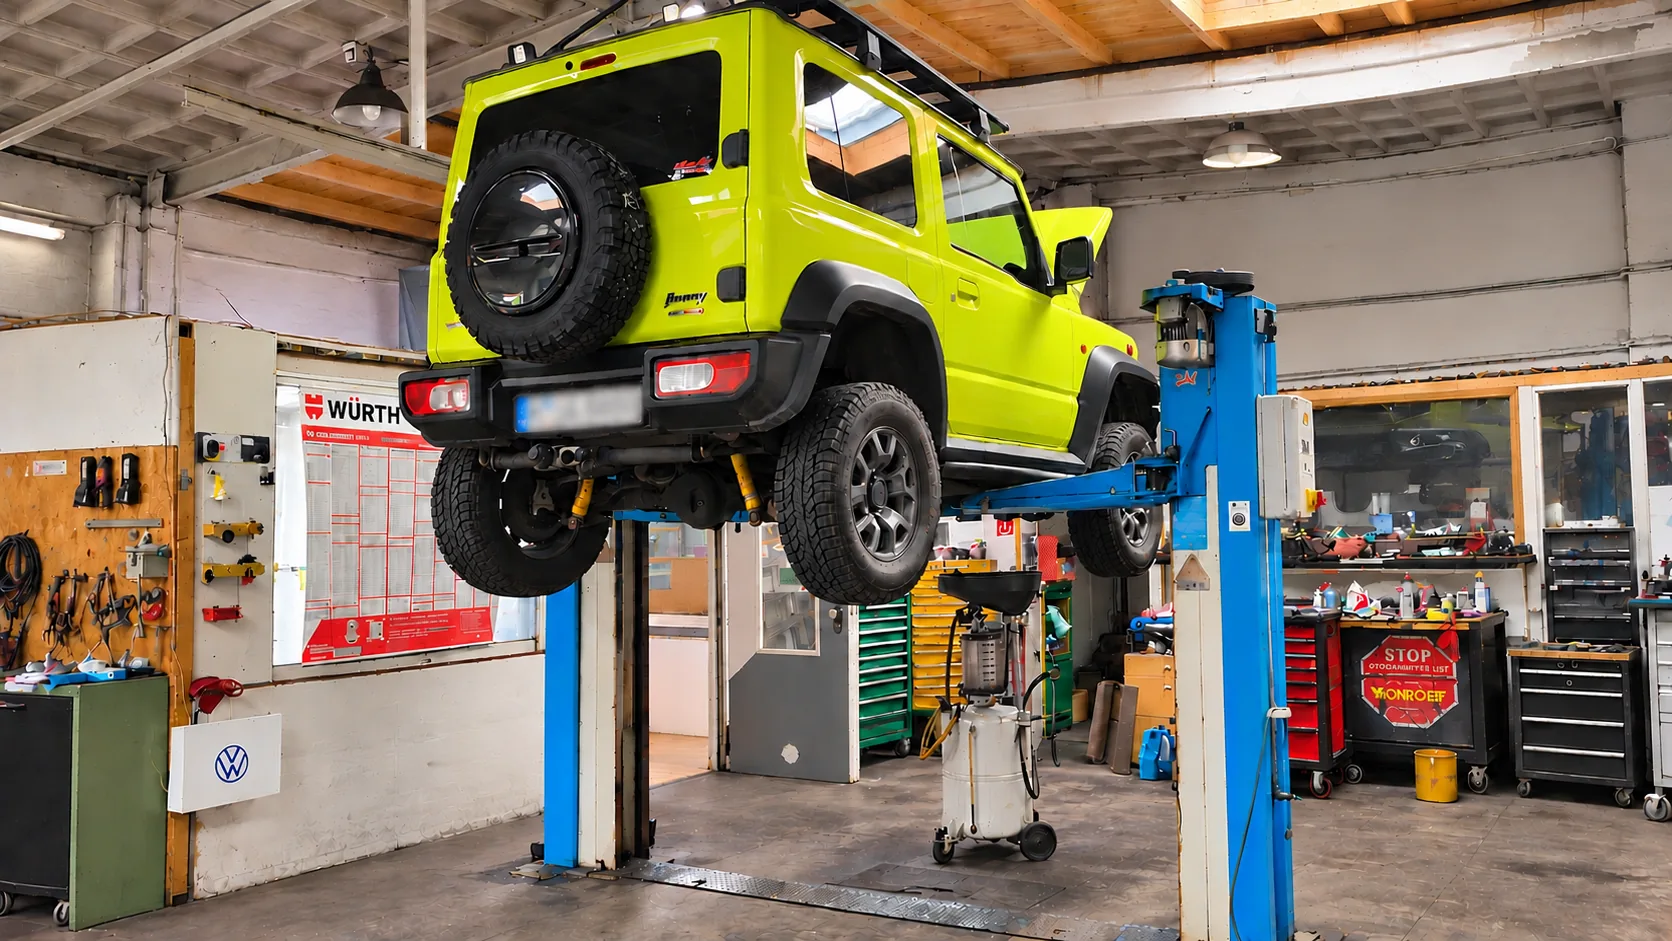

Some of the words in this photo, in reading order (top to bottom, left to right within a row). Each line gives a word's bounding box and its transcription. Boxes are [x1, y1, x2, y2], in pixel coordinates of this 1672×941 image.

[327, 396, 400, 425] WÜRTH
[1384, 648, 1432, 663] STOP
[215, 745, 248, 783] VW
